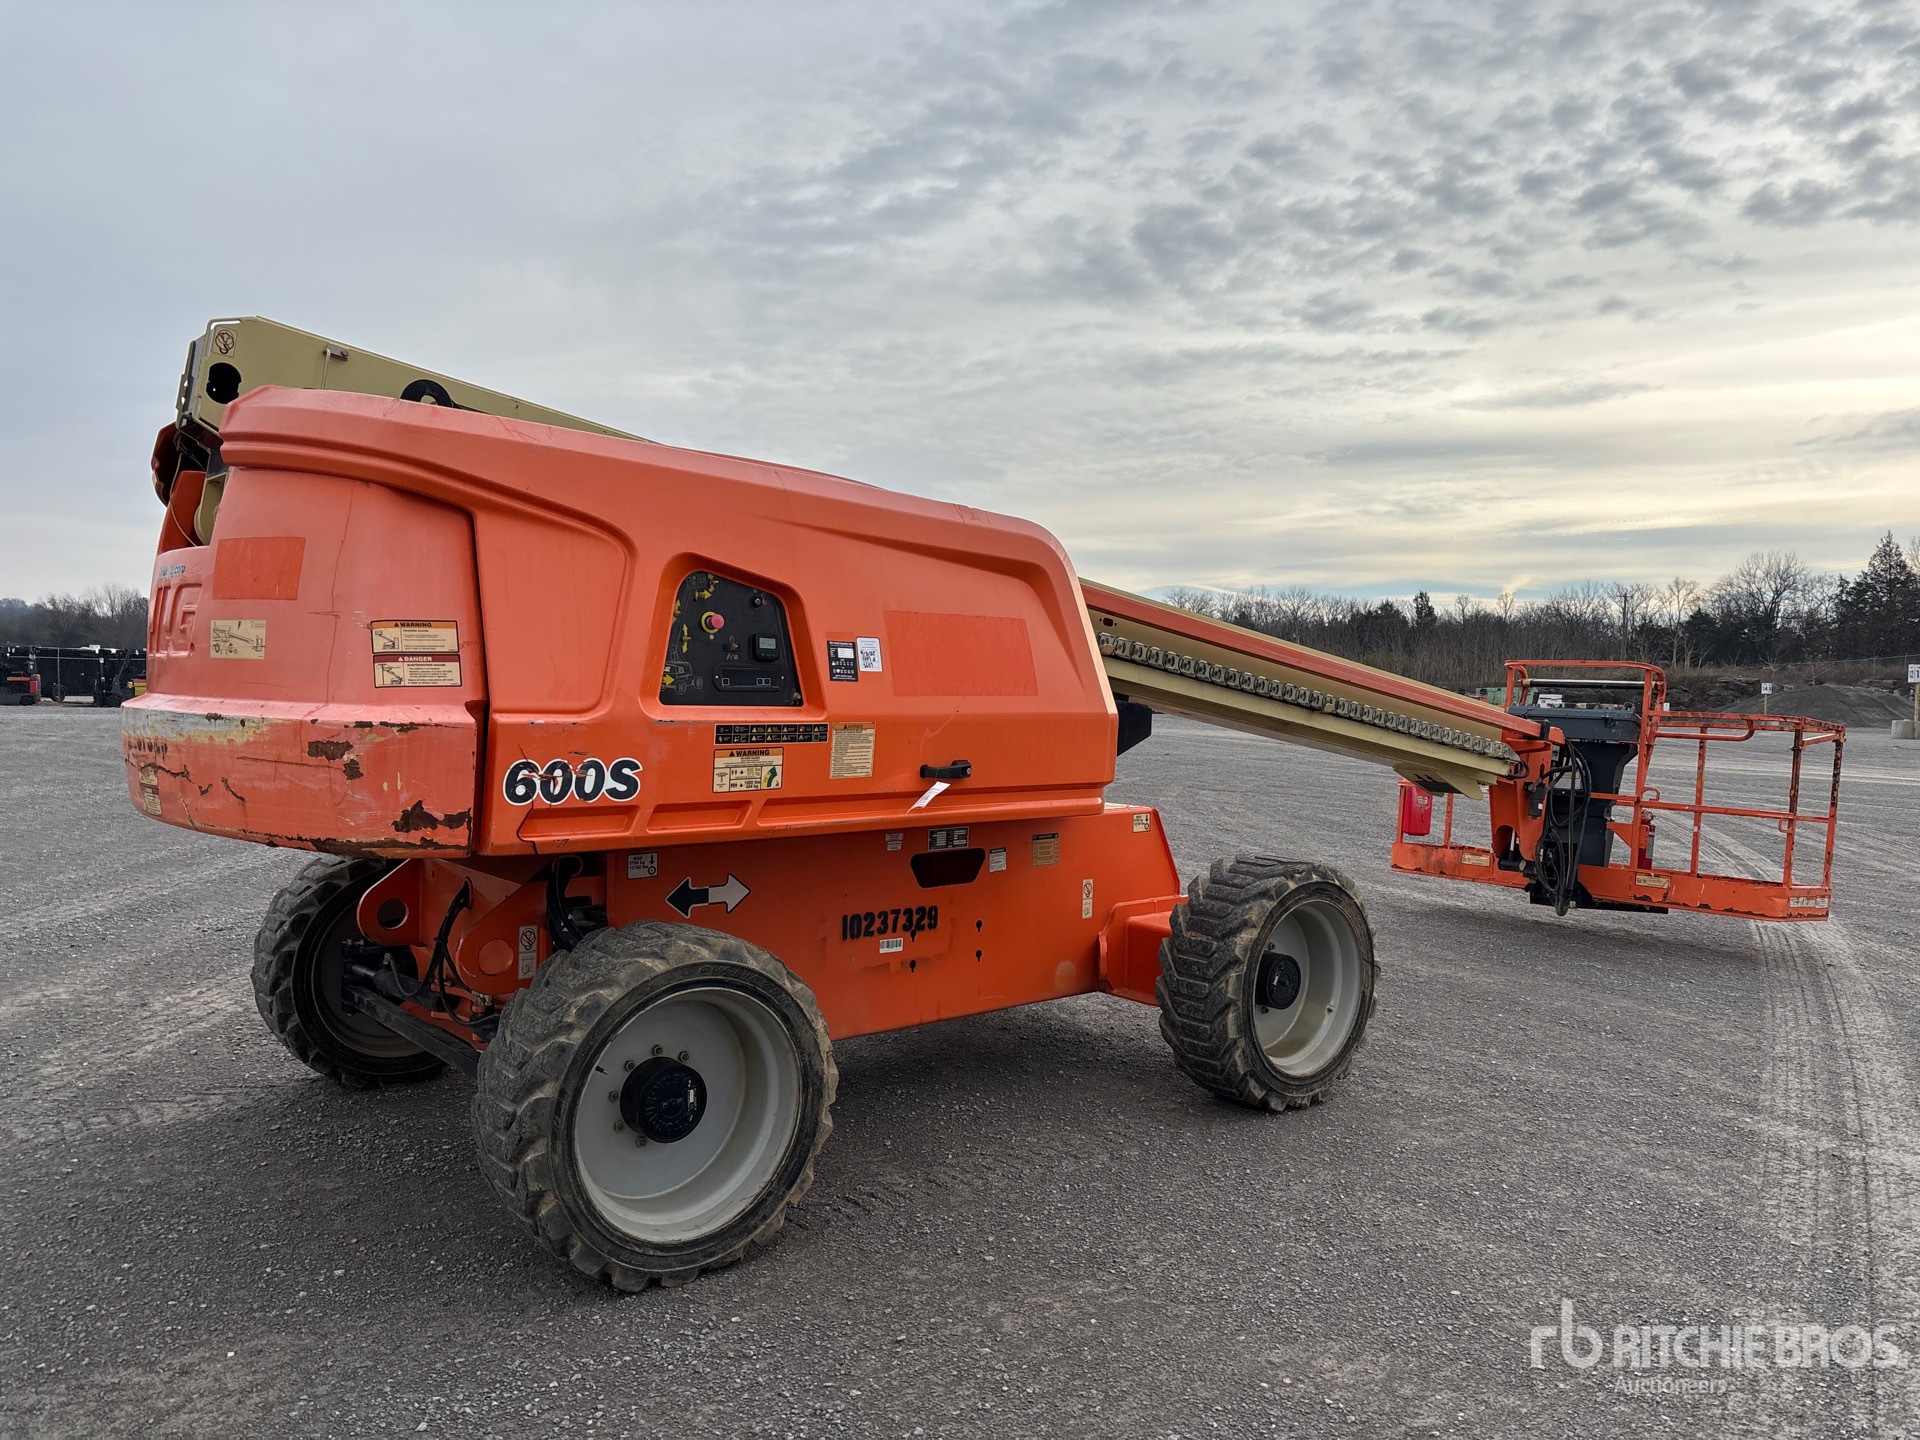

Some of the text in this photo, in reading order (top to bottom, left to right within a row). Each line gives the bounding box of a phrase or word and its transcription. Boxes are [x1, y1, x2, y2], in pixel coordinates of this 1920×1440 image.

[736, 749, 770, 757] WARNING
[503, 757, 643, 806] 600S
[842, 905, 938, 941] 10237329
